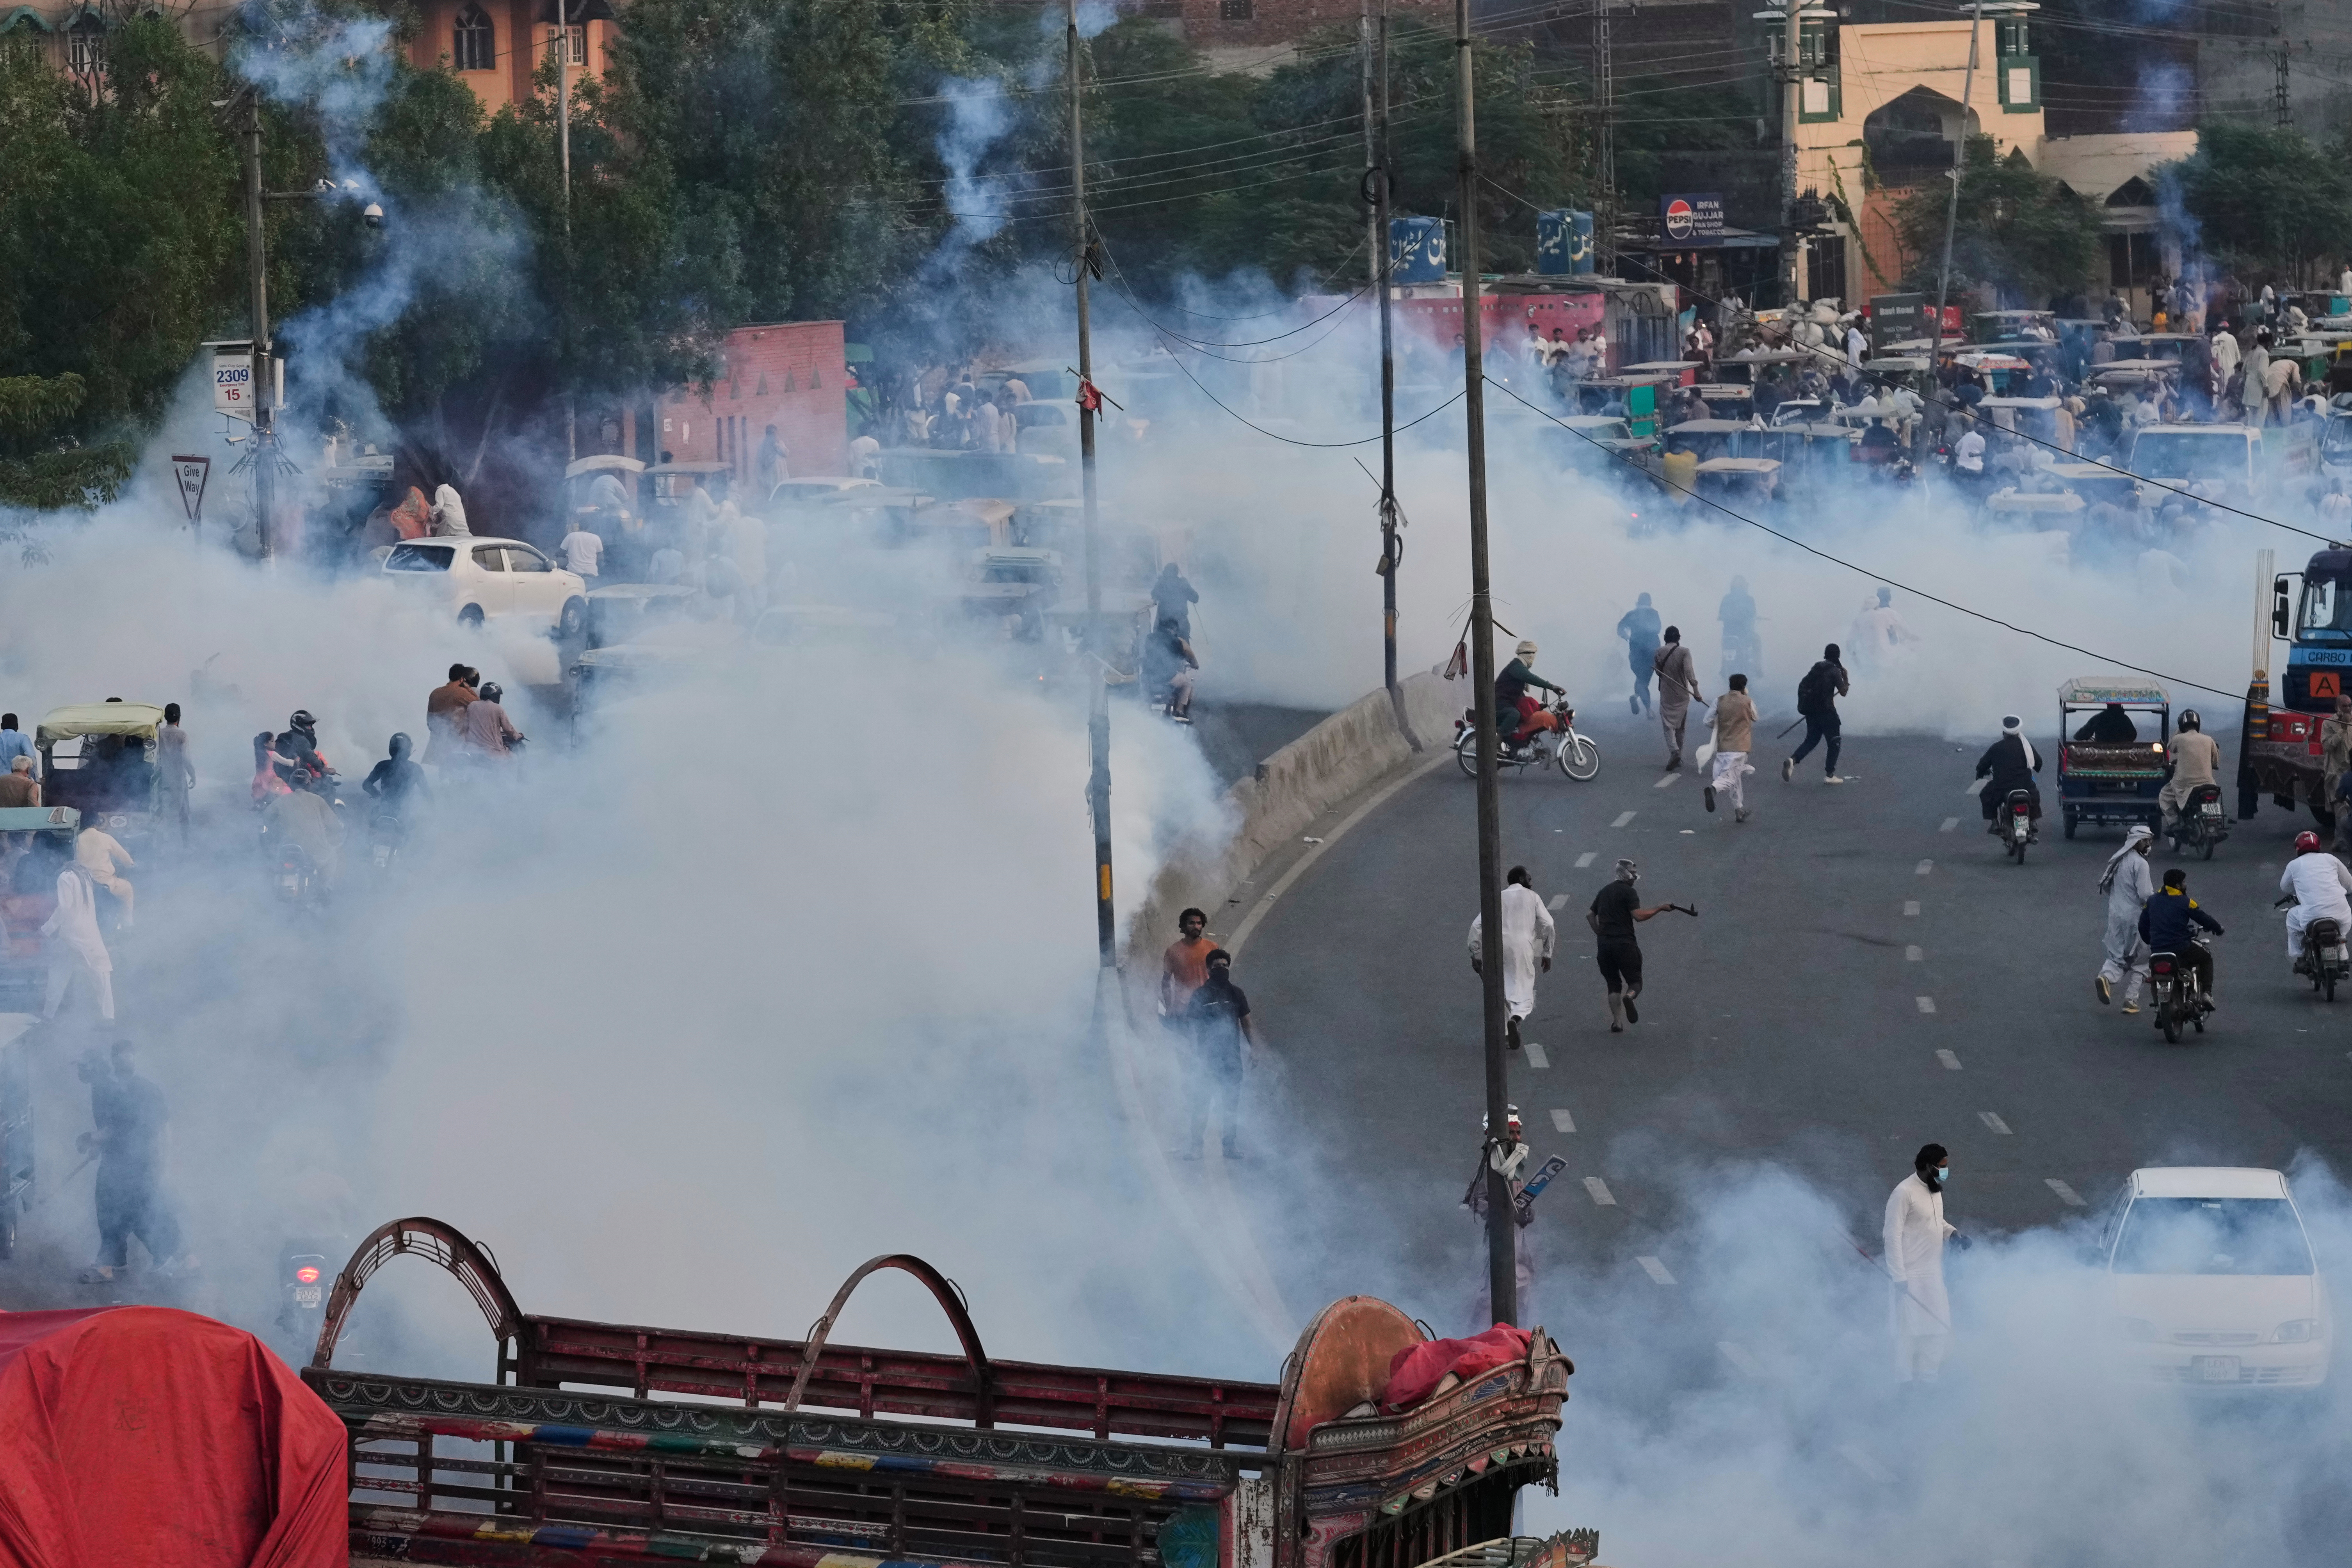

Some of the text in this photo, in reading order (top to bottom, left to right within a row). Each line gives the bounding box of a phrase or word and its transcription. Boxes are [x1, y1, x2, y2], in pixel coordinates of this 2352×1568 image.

[1697, 201, 1719, 209] IRFAN
[1668, 215, 1692, 224] PEPSI
[1693, 211, 1724, 219] GUJJAR
[216, 369, 249, 383] 2309
[225, 389, 240, 400] 15
[184, 465, 199, 477] Give
[184, 480, 199, 495] Way
[2308, 651, 2346, 663] CARBO
[2315, 676, 2334, 695] A
